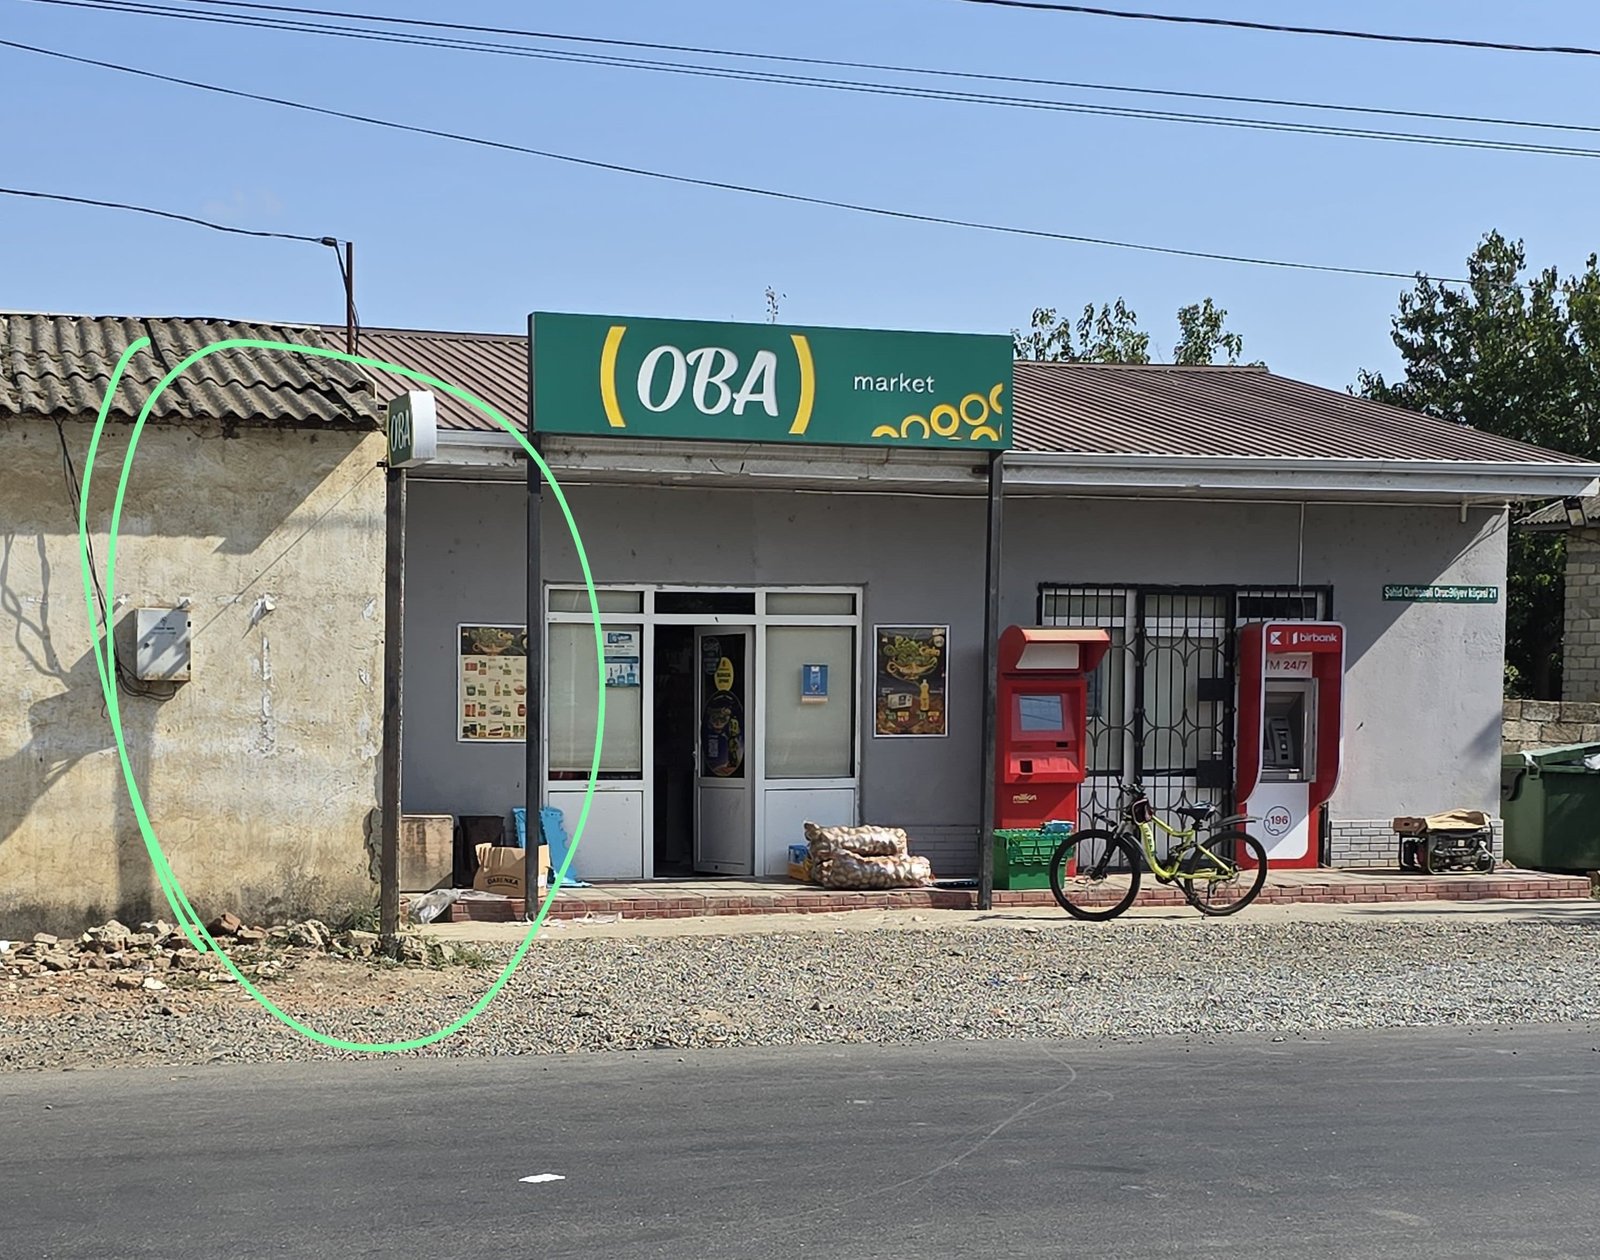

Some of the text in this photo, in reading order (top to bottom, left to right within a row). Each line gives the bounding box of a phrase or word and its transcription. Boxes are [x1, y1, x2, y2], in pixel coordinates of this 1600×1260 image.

[853, 373, 935, 394] market
[390, 409, 411, 452] OBA
[1300, 632, 1337, 642] birbank
[1283, 661, 1307, 670] 24/7
[1271, 816, 1288, 825] 196
